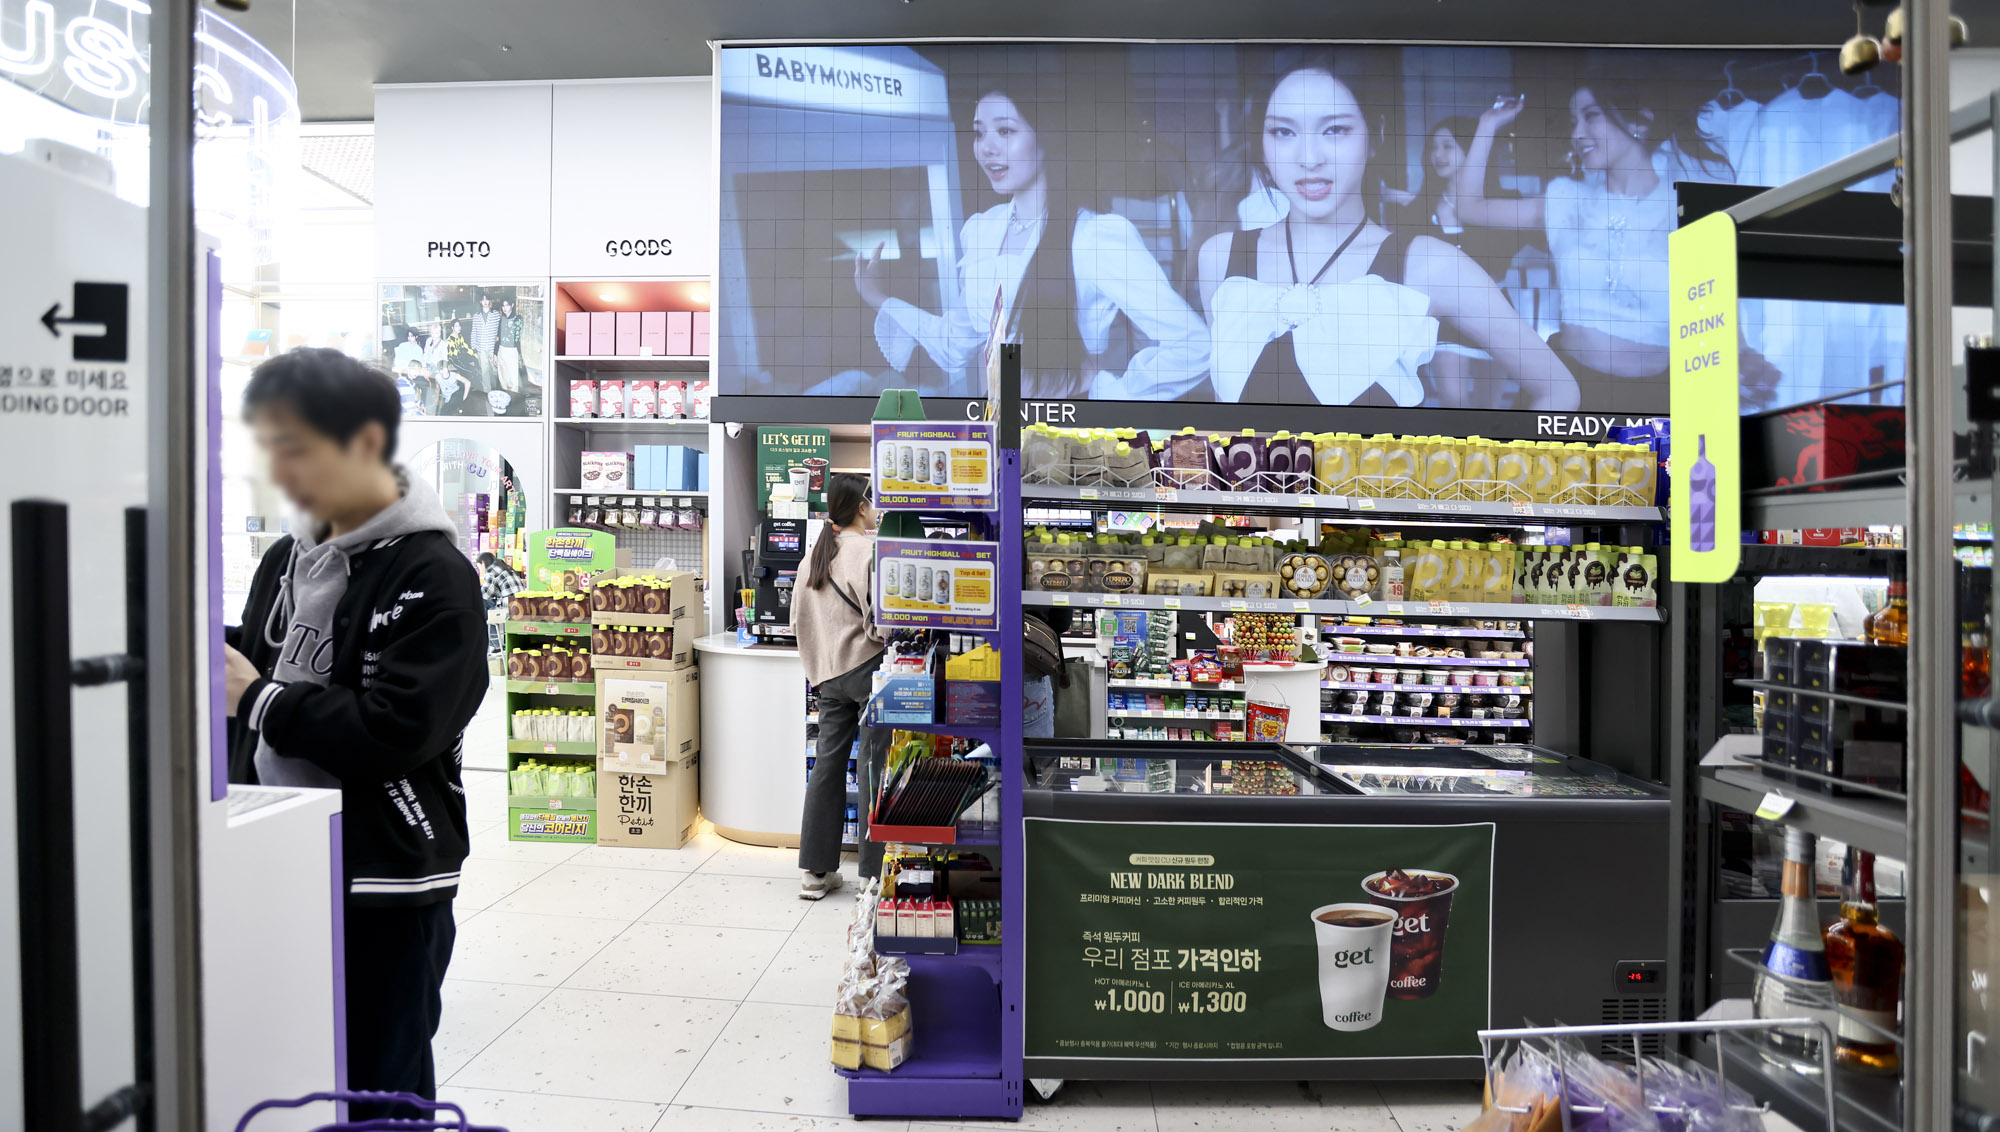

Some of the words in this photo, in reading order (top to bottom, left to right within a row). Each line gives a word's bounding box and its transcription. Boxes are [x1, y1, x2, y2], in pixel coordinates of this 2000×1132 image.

[428, 241, 490, 258] PHOTO
[606, 239, 672, 257] GOODS
[1688, 279, 1715, 301] GET
[1680, 312, 1725, 339] DRINK
[1685, 350, 1720, 373] LOVE
[66, 369, 128, 390] 미세요
[63, 397, 128, 417] DOOR
[1537, 415, 1615, 436] READY
[762, 433, 789, 446] LET'S
[791, 434, 810, 446] GET
[812, 435, 826, 446] IT!
[467, 463, 487, 478] CU
[501, 475, 521, 508] ARTIST
[901, 549, 923, 557] FRUIT
[924, 550, 960, 558] HIGHBALL
[618, 774, 652, 794] 한손
[393, 797, 418, 826] ENOUGH
[618, 795, 652, 814] 한끼
[411, 801, 426, 821] YOUR
[421, 820, 434, 839] BEST
[617, 814, 655, 827] Petit
[1160, 856, 1170, 864] CU
[1171, 856, 1183, 864] 신규
[1110, 872, 1142, 889] NEW
[1147, 872, 1185, 889] DARK
[1190, 873, 1234, 890] BLEND
[1080, 893, 1110, 903] 프리미엄
[1111, 895, 1141, 905] 커피머신
[1153, 896, 1176, 905] 고소한
[1176, 896, 1206, 906] 커피원두
[1218, 896, 1248, 906] 합리적인
[1248, 896, 1264, 906] 가격
[1082, 931, 1102, 943] 즉석
[1103, 931, 1141, 943] 원두커피
[1082, 946, 1123, 970] 우리
[1130, 947, 1173, 971] 점포
[1177, 948, 1262, 972] 가격인하
[1334, 946, 1374, 968] get
[1111, 978, 1144, 988] 아메리카노
[1390, 975, 1426, 988] coffee
[1094, 988, 1165, 1013] ₩1,000
[1178, 991, 1247, 1013] ₩1,300
[1335, 1011, 1372, 1023] coffee
